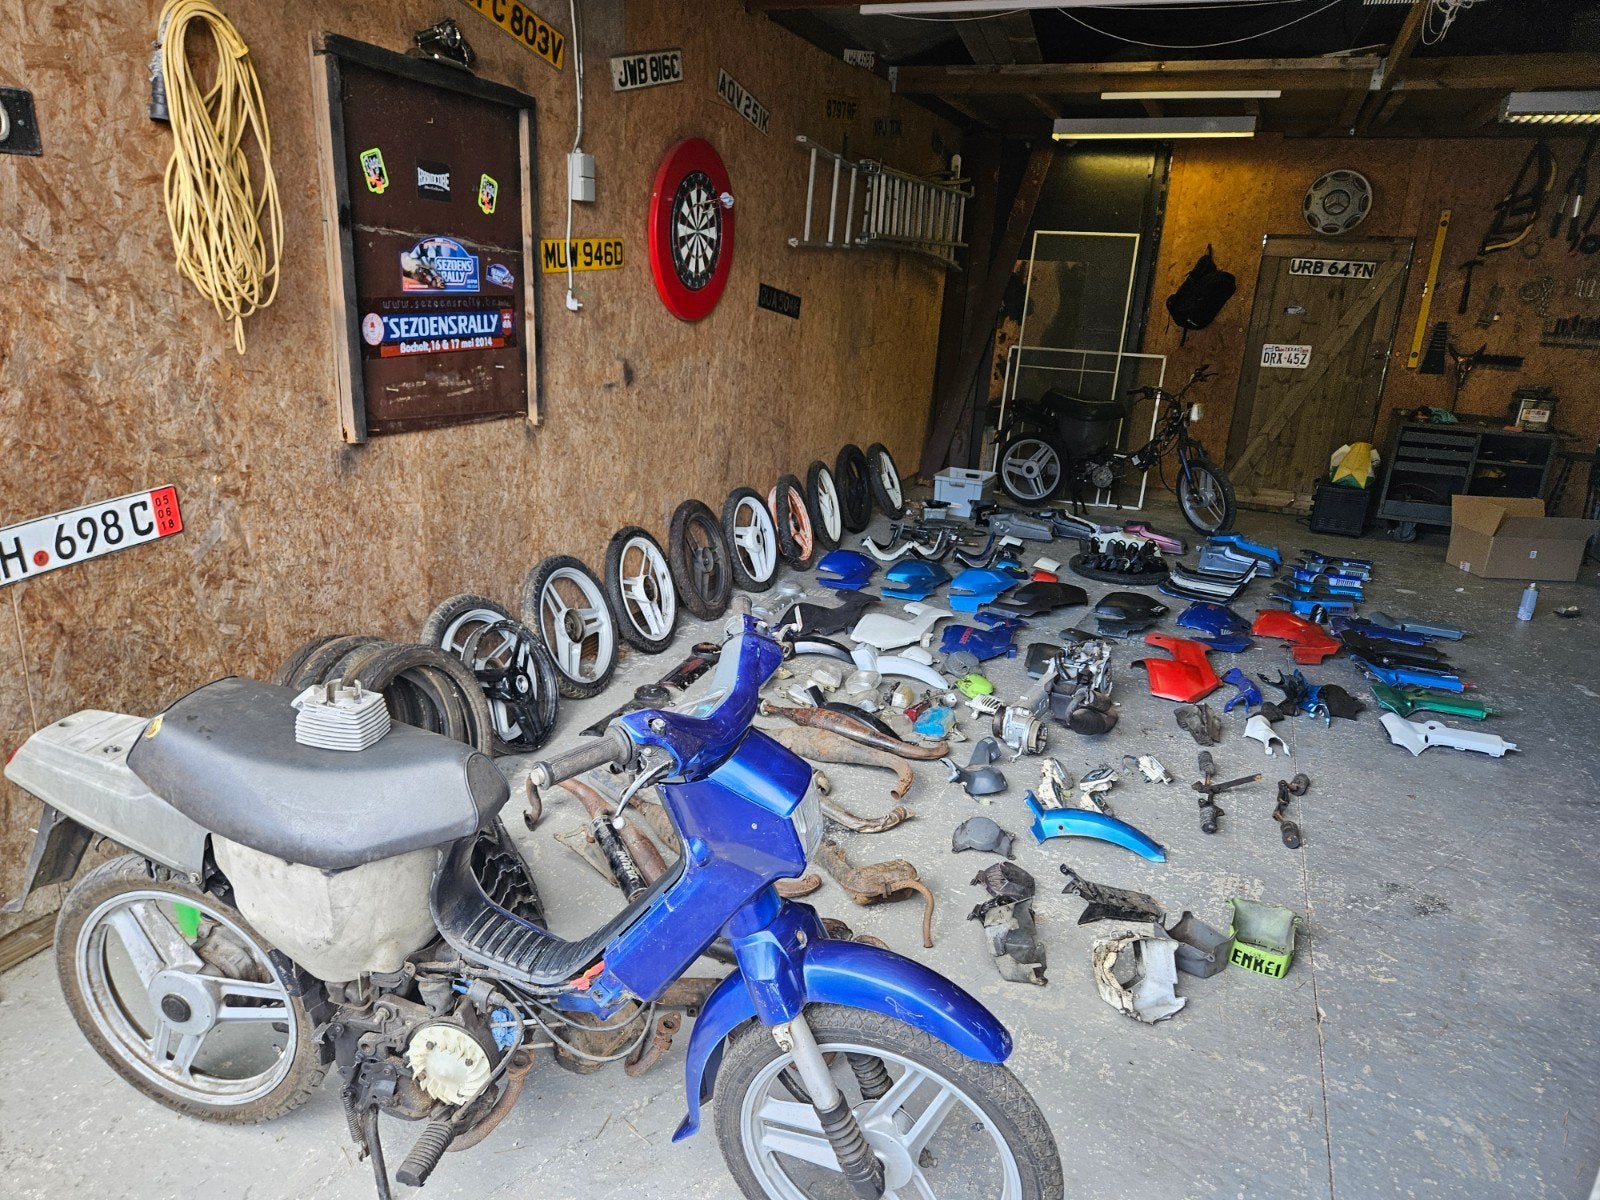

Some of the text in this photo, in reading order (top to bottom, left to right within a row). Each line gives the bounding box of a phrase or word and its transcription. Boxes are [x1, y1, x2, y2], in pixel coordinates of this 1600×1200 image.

[510, 4, 563, 63] 803V
[618, 53, 681, 87] JWB 816C
[743, 95, 770, 134] 251K
[435, 260, 473, 271] SEZOENS
[544, 241, 623, 268] MUW 946D
[441, 271, 467, 283] RALLY
[1290, 259, 1375, 278] URB 647N
[389, 314, 499, 339] SEZOENSRALLY
[450, 338, 460, 349] 17
[461, 338, 474, 348] mei
[475, 336, 493, 347] 2014
[155, 494, 169, 507] 05
[158, 508, 172, 519] 06
[161, 520, 175, 531] 18
[0, 536, 28, 580] H
[1231, 948, 1281, 977] ENKEI
